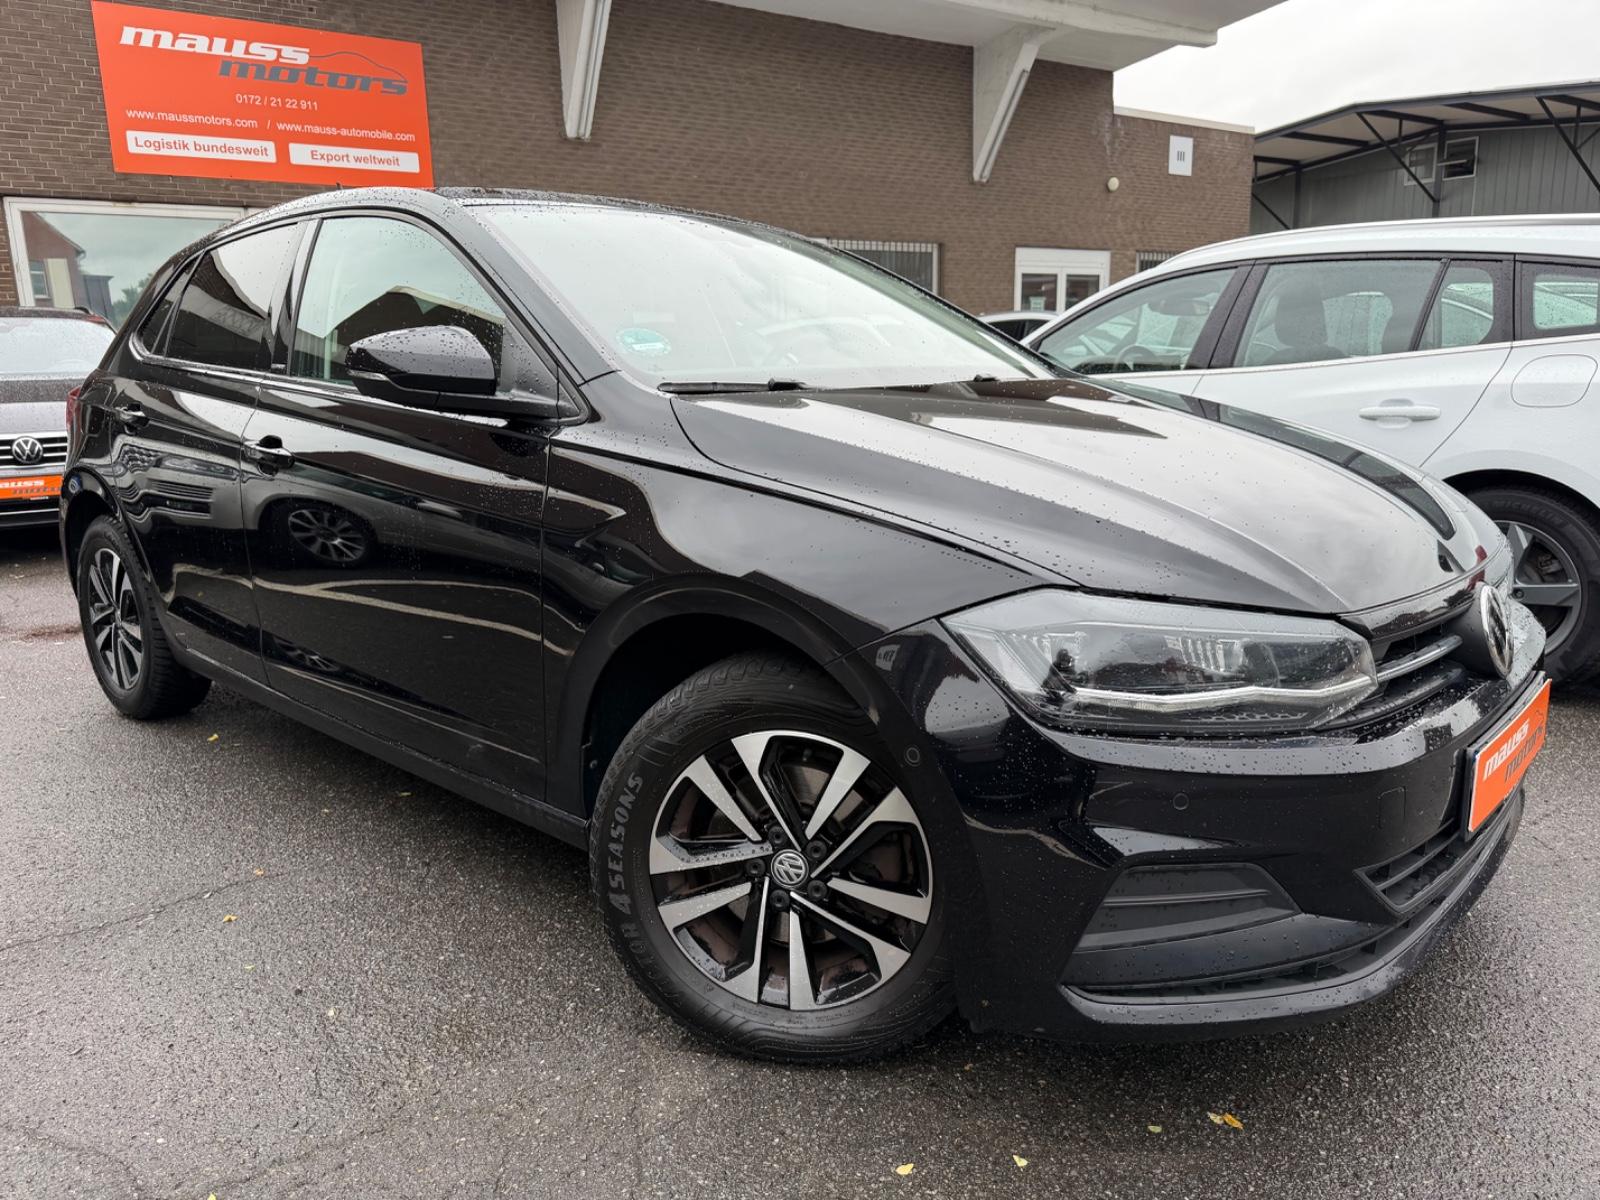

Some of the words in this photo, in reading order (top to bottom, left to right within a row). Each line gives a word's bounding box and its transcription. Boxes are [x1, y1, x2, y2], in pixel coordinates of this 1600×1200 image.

[119, 25, 310, 65] mauss
[218, 59, 409, 96] motors
[235, 93, 261, 105] 0172
[270, 97, 282, 107] 21
[285, 98, 298, 109] 22
[300, 100, 318, 111] 911
[125, 109, 258, 129] www.maussmotors.com
[276, 120, 416, 142] www.mauss-automobile.com
[134, 136, 190, 151] Logistik
[193, 140, 269, 157] bundesweit
[310, 150, 350, 164] Export
[353, 153, 400, 167] weltweit
[1483, 717, 1530, 782] mauss
[608, 772, 643, 915] 4SEASONS
